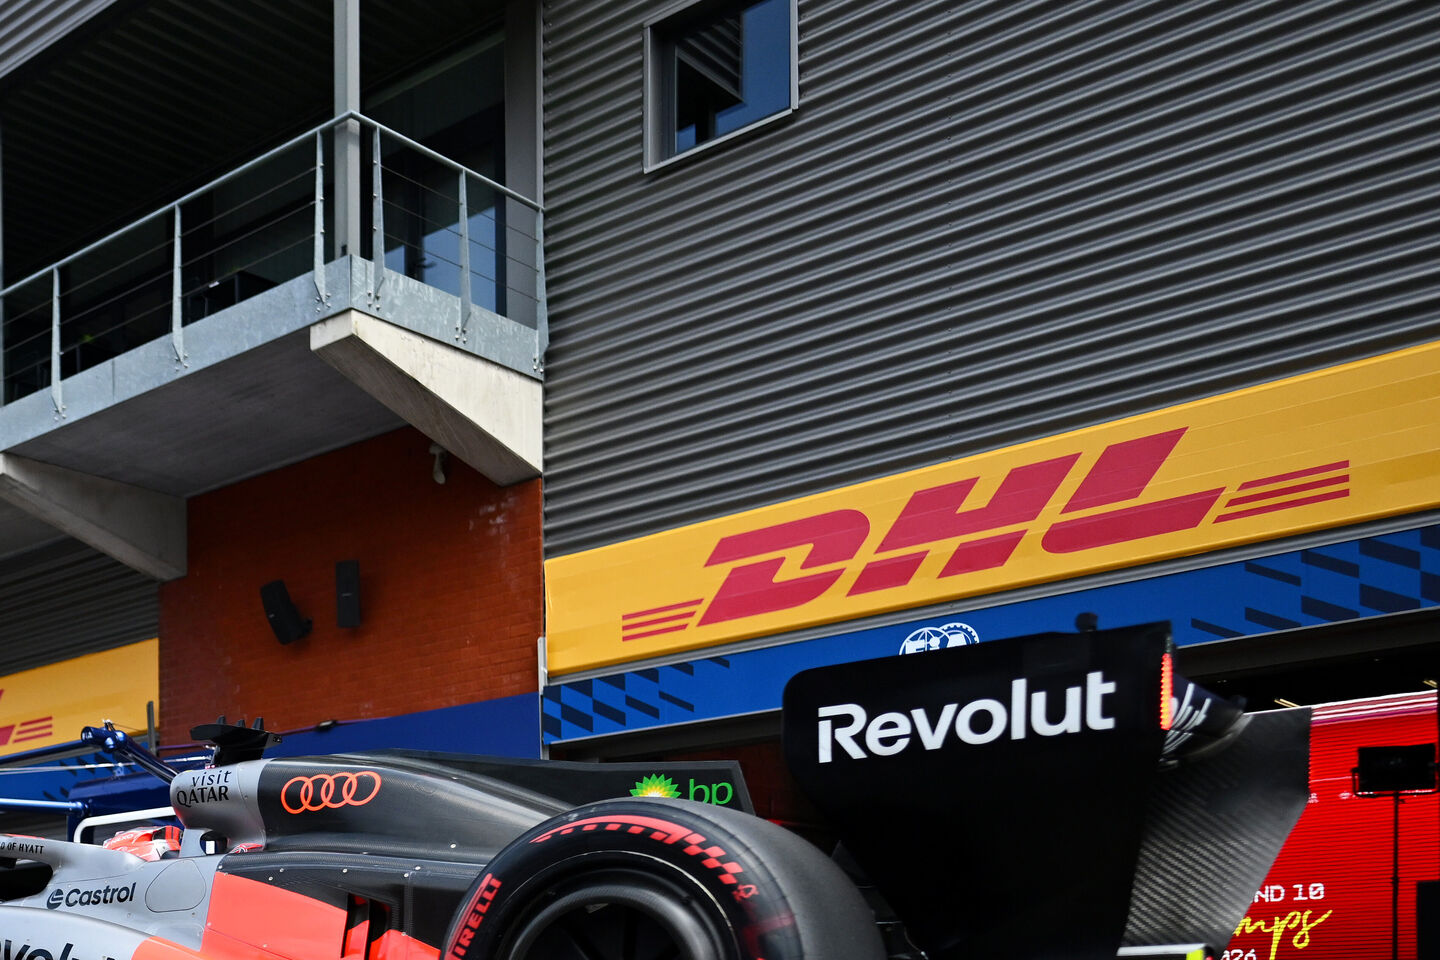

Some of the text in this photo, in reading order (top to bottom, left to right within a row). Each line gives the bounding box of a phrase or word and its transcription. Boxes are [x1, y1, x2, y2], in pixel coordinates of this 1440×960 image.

[696, 426, 1227, 628] DHL
[818, 671, 1116, 764] Revolut
[192, 769, 233, 787] visit
[176, 785, 230, 808] QATAR
[688, 778, 734, 805] bp
[7, 842, 17, 851] OF
[18, 843, 45, 854] HYATT
[65, 882, 137, 907] Castrol
[1252, 883, 1325, 902] ND 10
